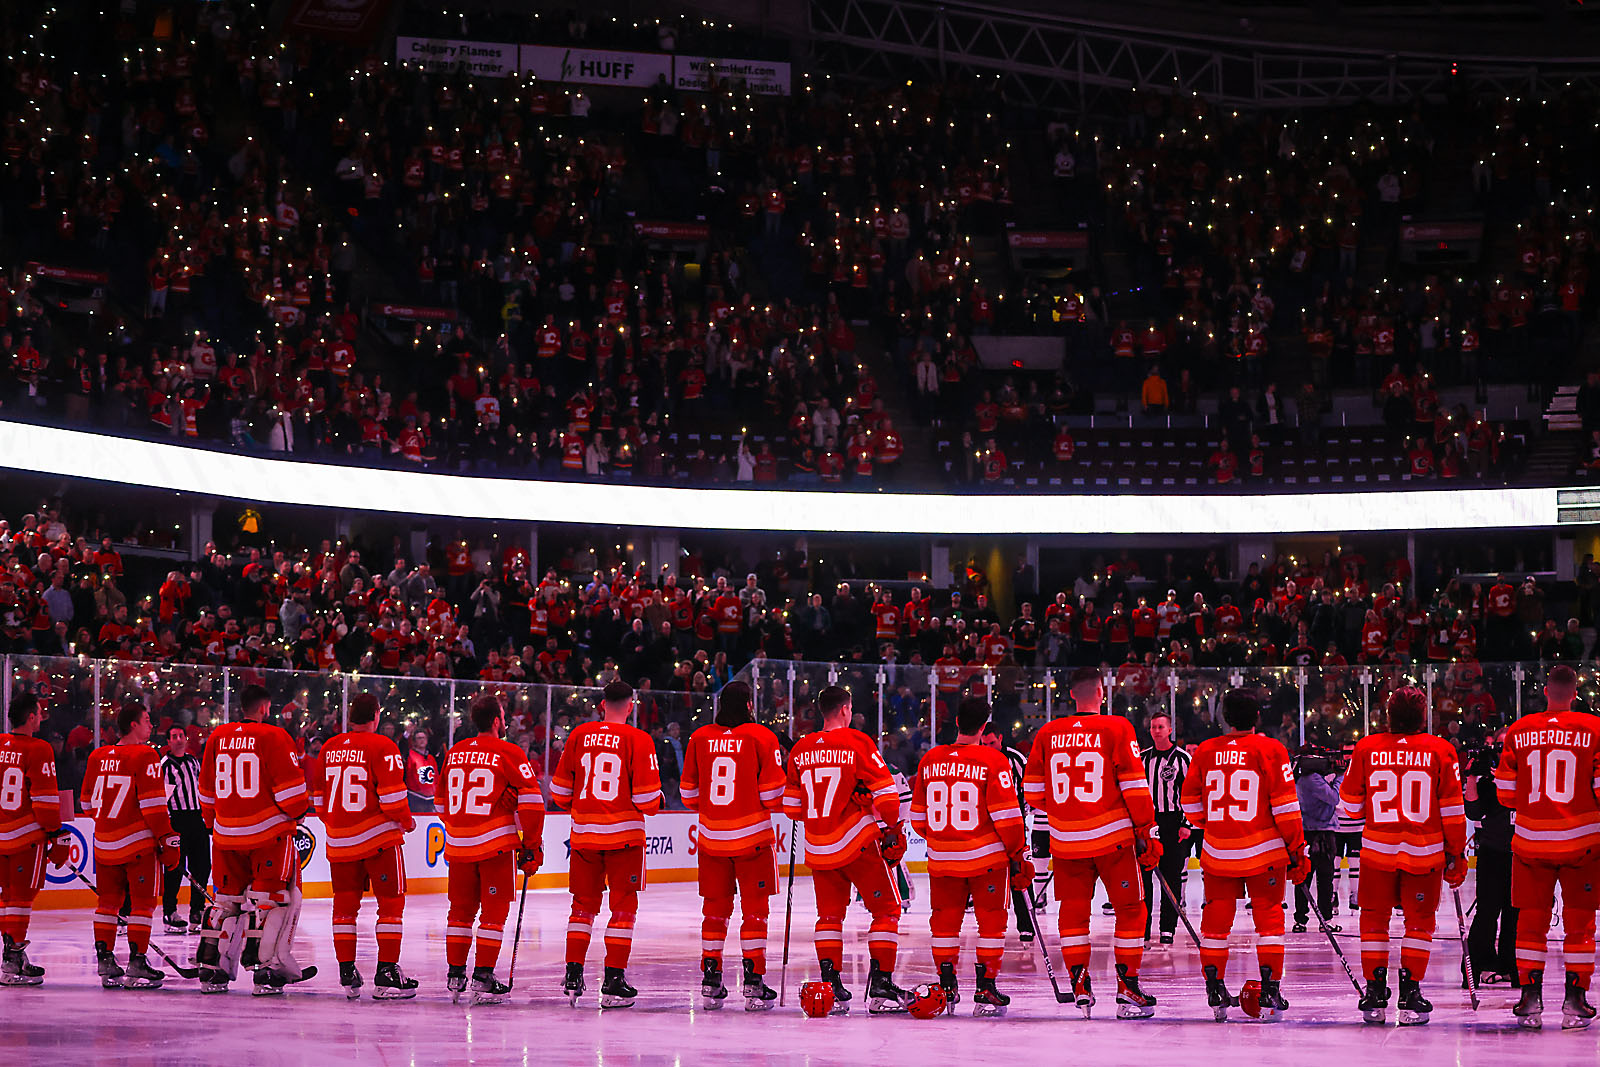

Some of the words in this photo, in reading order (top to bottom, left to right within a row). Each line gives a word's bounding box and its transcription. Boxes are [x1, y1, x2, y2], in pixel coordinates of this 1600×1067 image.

[411, 42, 457, 56] Calgary
[459, 46, 502, 57] Flames
[580, 60, 634, 79] HUFF
[326, 750, 366, 763] POSPISIL
[584, 734, 620, 749] GREER
[708, 739, 743, 753] TANEV
[774, 749, 783, 766] 8
[1051, 733, 1101, 749] RUZICKA
[1215, 751, 1247, 766] DUBE
[1371, 751, 1432, 767] COLEMAN
[1514, 730, 1591, 749] HUBERDEAU
[146, 763, 161, 778] 47
[215, 752, 260, 799] 80
[384, 754, 405, 771] 76
[580, 752, 622, 802] 18
[710, 756, 737, 806] 8
[1050, 751, 1105, 804] 63
[1527, 749, 1577, 804] 10
[1, 767, 24, 811] 8
[91, 775, 132, 819] 47
[325, 766, 368, 813] 76
[447, 768, 495, 816] 82
[800, 766, 842, 819] 17
[926, 781, 979, 831] 88
[1205, 769, 1260, 822] 29
[1369, 770, 1432, 823] 20
